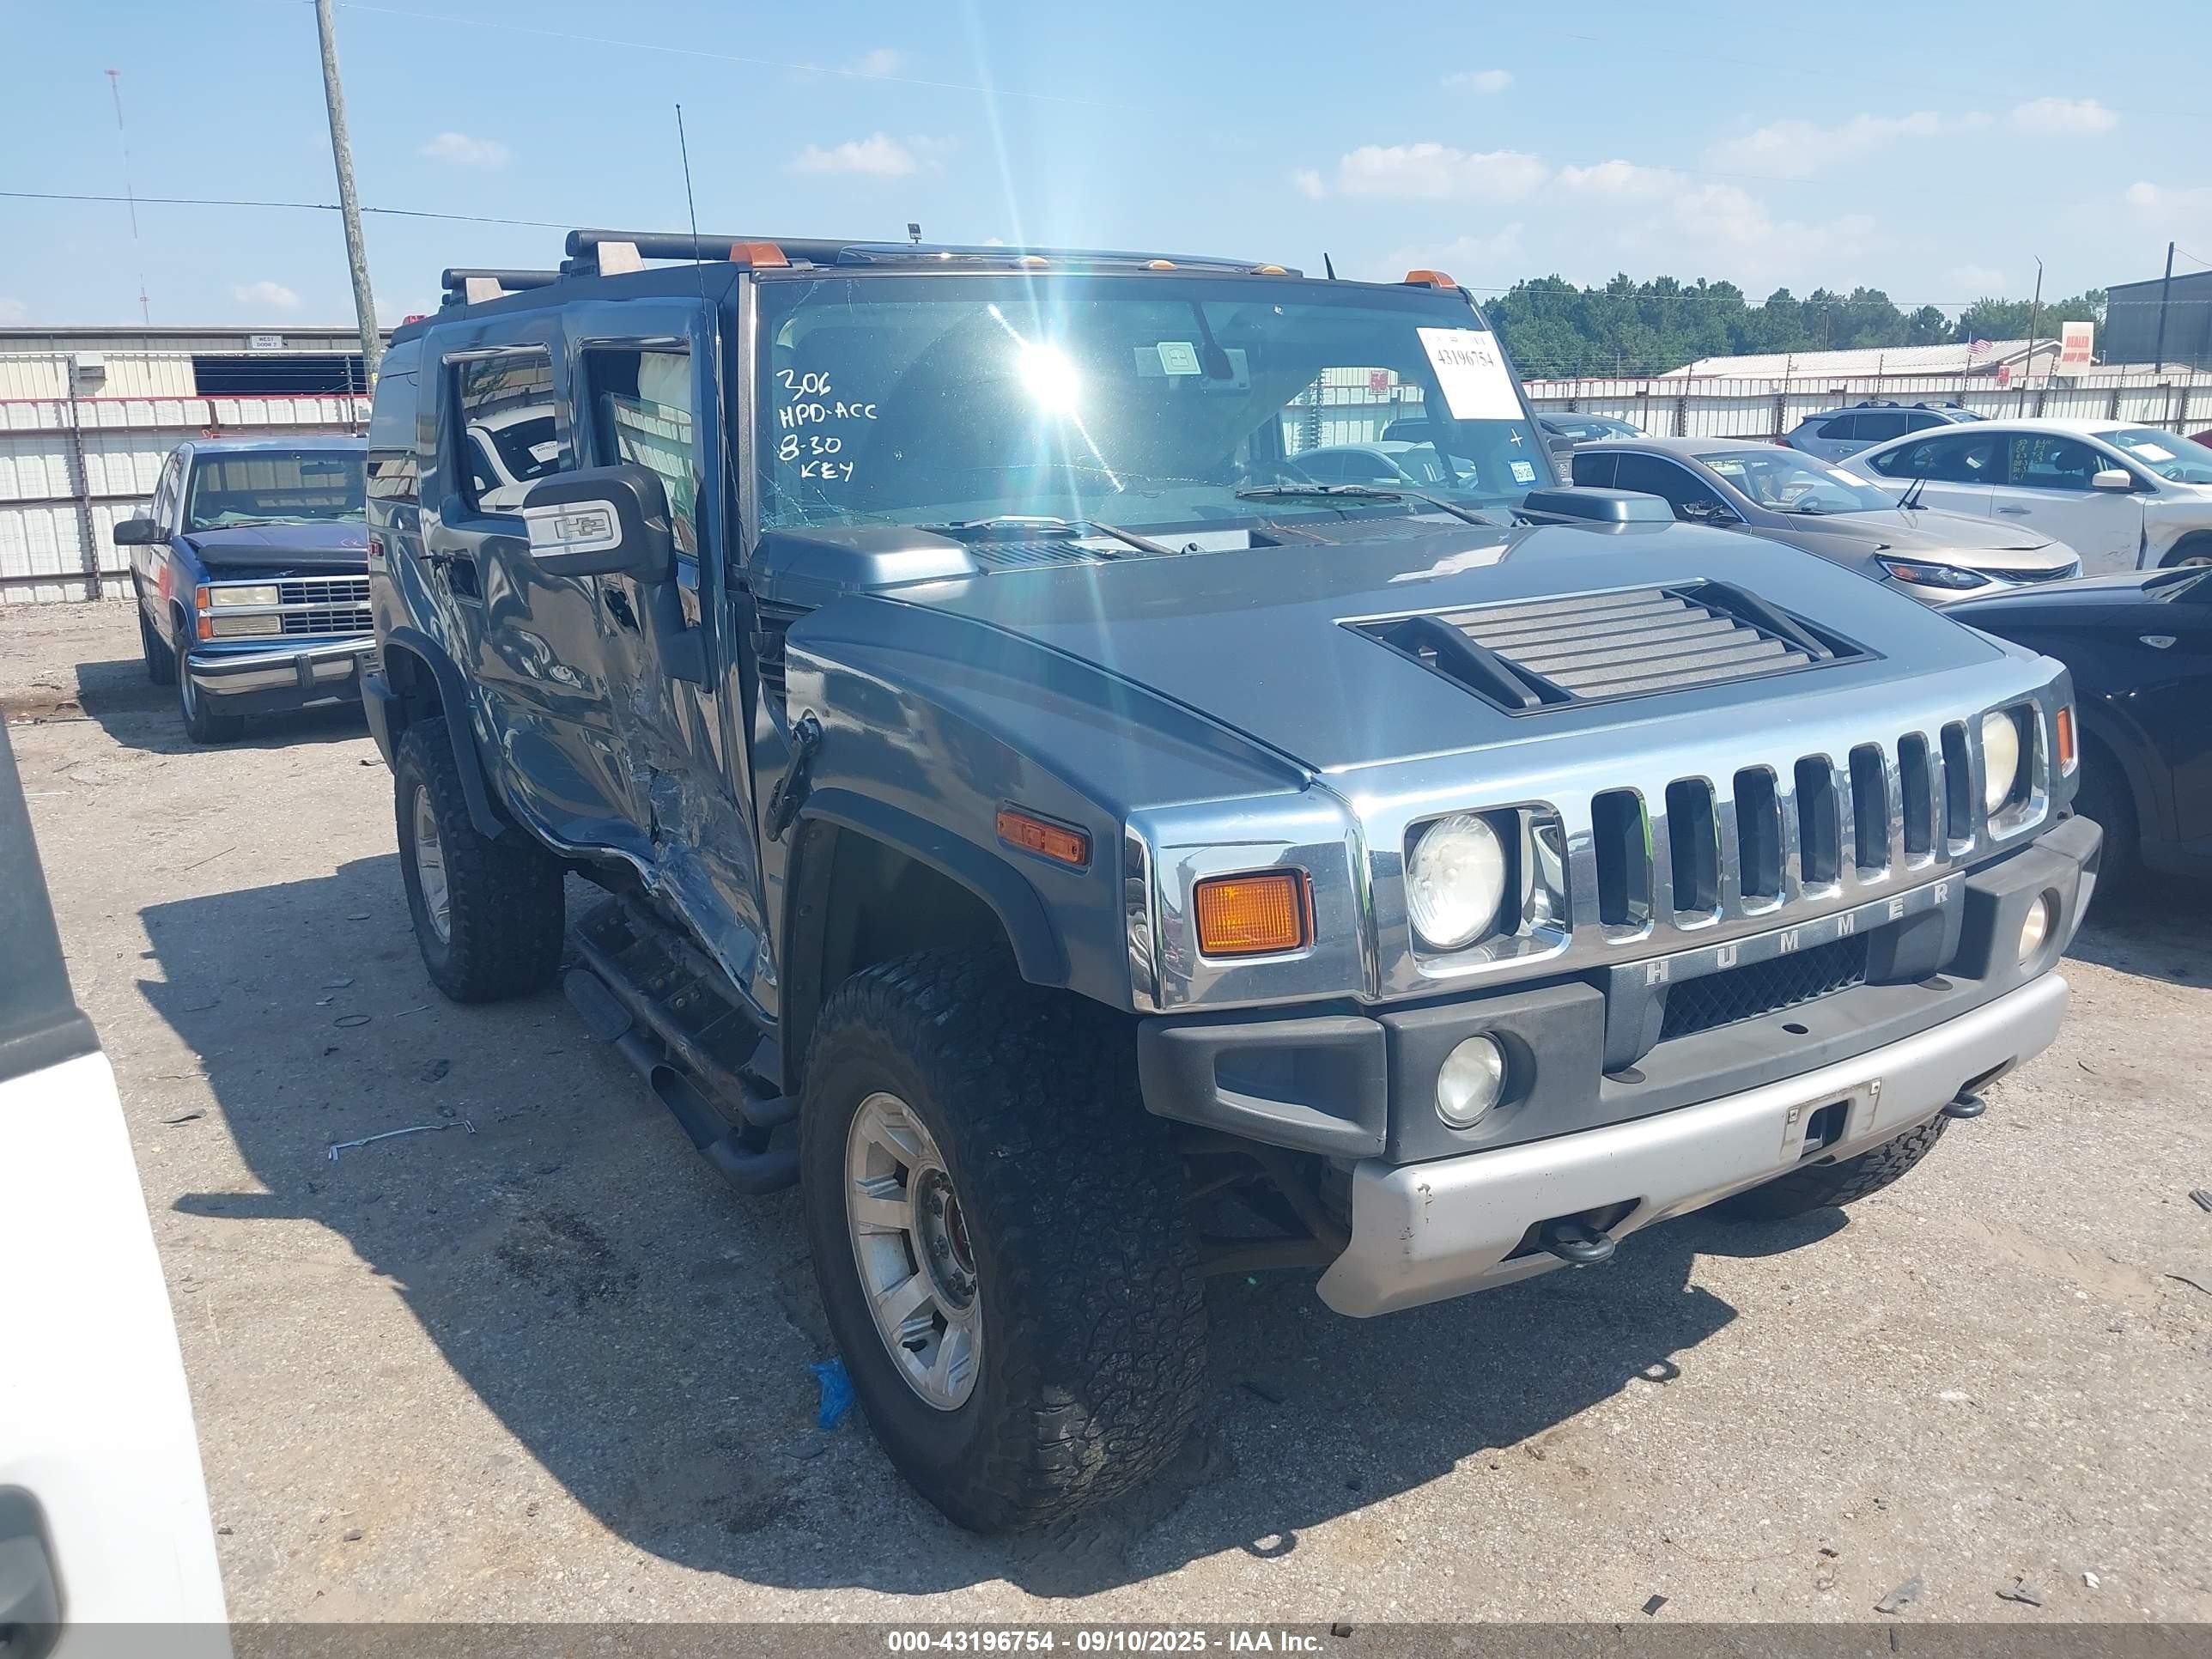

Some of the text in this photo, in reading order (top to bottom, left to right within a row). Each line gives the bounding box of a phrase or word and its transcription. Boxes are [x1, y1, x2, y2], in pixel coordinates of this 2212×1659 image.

[2066, 336, 2089, 348] DEALER
[1437, 349, 1494, 367] 43196754
[775, 368, 832, 402] 306
[778, 434, 842, 461] 8-30
[800, 460, 854, 483] KEY
[554, 516, 606, 539] H2
[1645, 883, 1948, 986] HUMMER
